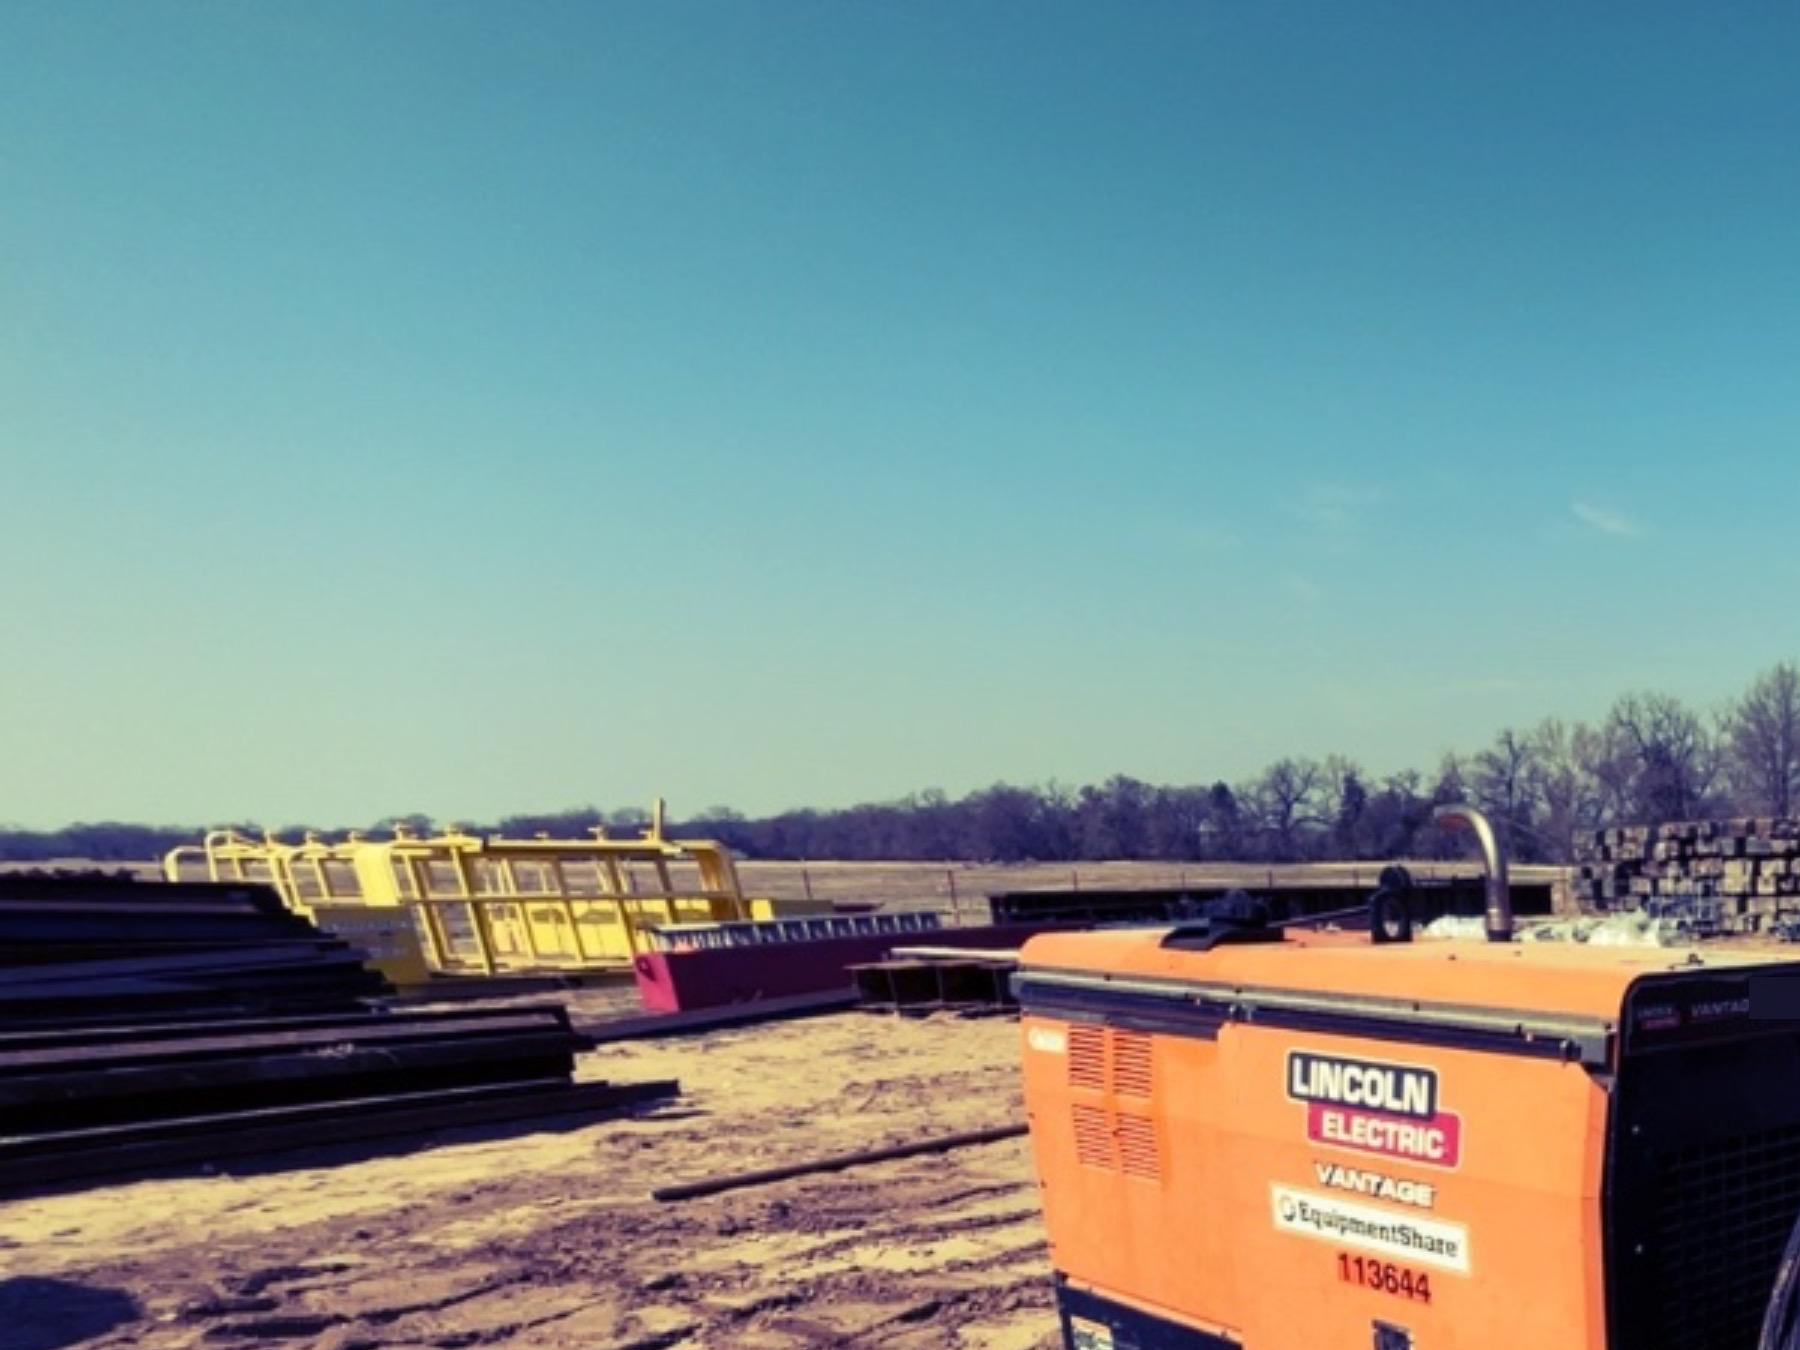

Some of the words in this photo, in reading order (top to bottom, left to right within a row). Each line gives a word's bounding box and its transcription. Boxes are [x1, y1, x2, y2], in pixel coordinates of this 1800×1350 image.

[1291, 1056, 1430, 1116] LINCOLN
[1321, 1110, 1445, 1159] ELECTRIC
[1315, 1162, 1436, 1208] VANTAGE
[1299, 1200, 1460, 1258] EquipmentShare
[1338, 1252, 1432, 1304] 113644
